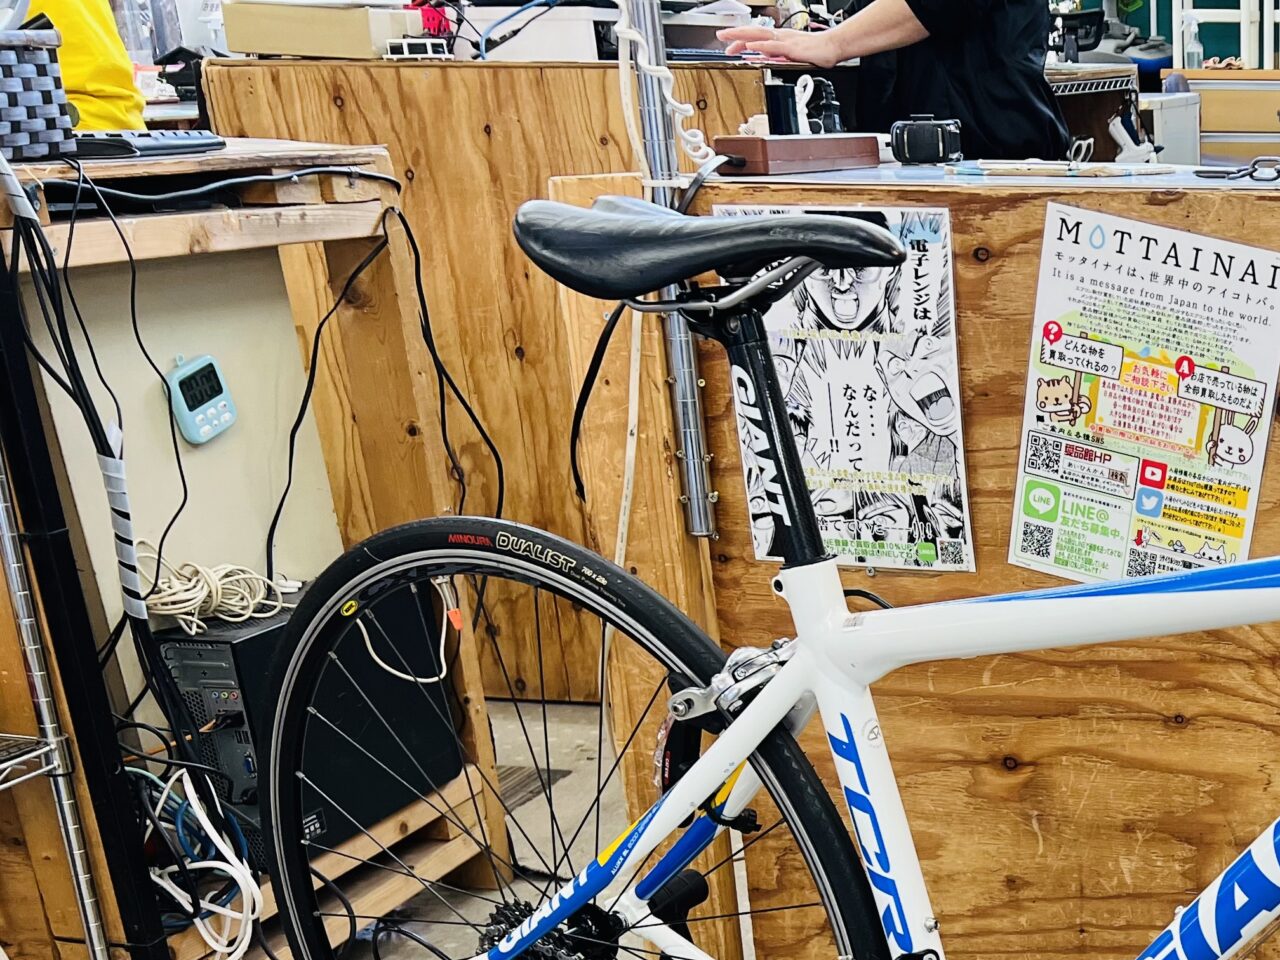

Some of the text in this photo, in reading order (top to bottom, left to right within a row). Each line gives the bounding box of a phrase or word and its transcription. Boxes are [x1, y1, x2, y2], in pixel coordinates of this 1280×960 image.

[909, 238, 931, 321] 電子レンジは
[1052, 267, 1062, 279] It
[1065, 271, 1075, 282] is
[1089, 278, 1135, 296] message
[1140, 287, 1164, 303] from
[1169, 294, 1198, 312] Japan
[1202, 302, 1214, 315] to
[1217, 305, 1234, 320] the
[1238, 311, 1272, 327] world.
[1064, 339, 1105, 358] どんな物を
[1123, 373, 1174, 393] ご相談下さい
[1132, 364, 1168, 380] お気軽に
[842, 384, 863, 472] なんだって
[1064, 443, 1112, 465] 愛品館HP
[1033, 494, 1052, 506] LINE
[1061, 499, 1110, 522] LINE@
[448, 534, 493, 547] MINOURA
[496, 531, 576, 573] DUALIST
[827, 712, 913, 954] TCR
[498, 865, 589, 953] GIANT
